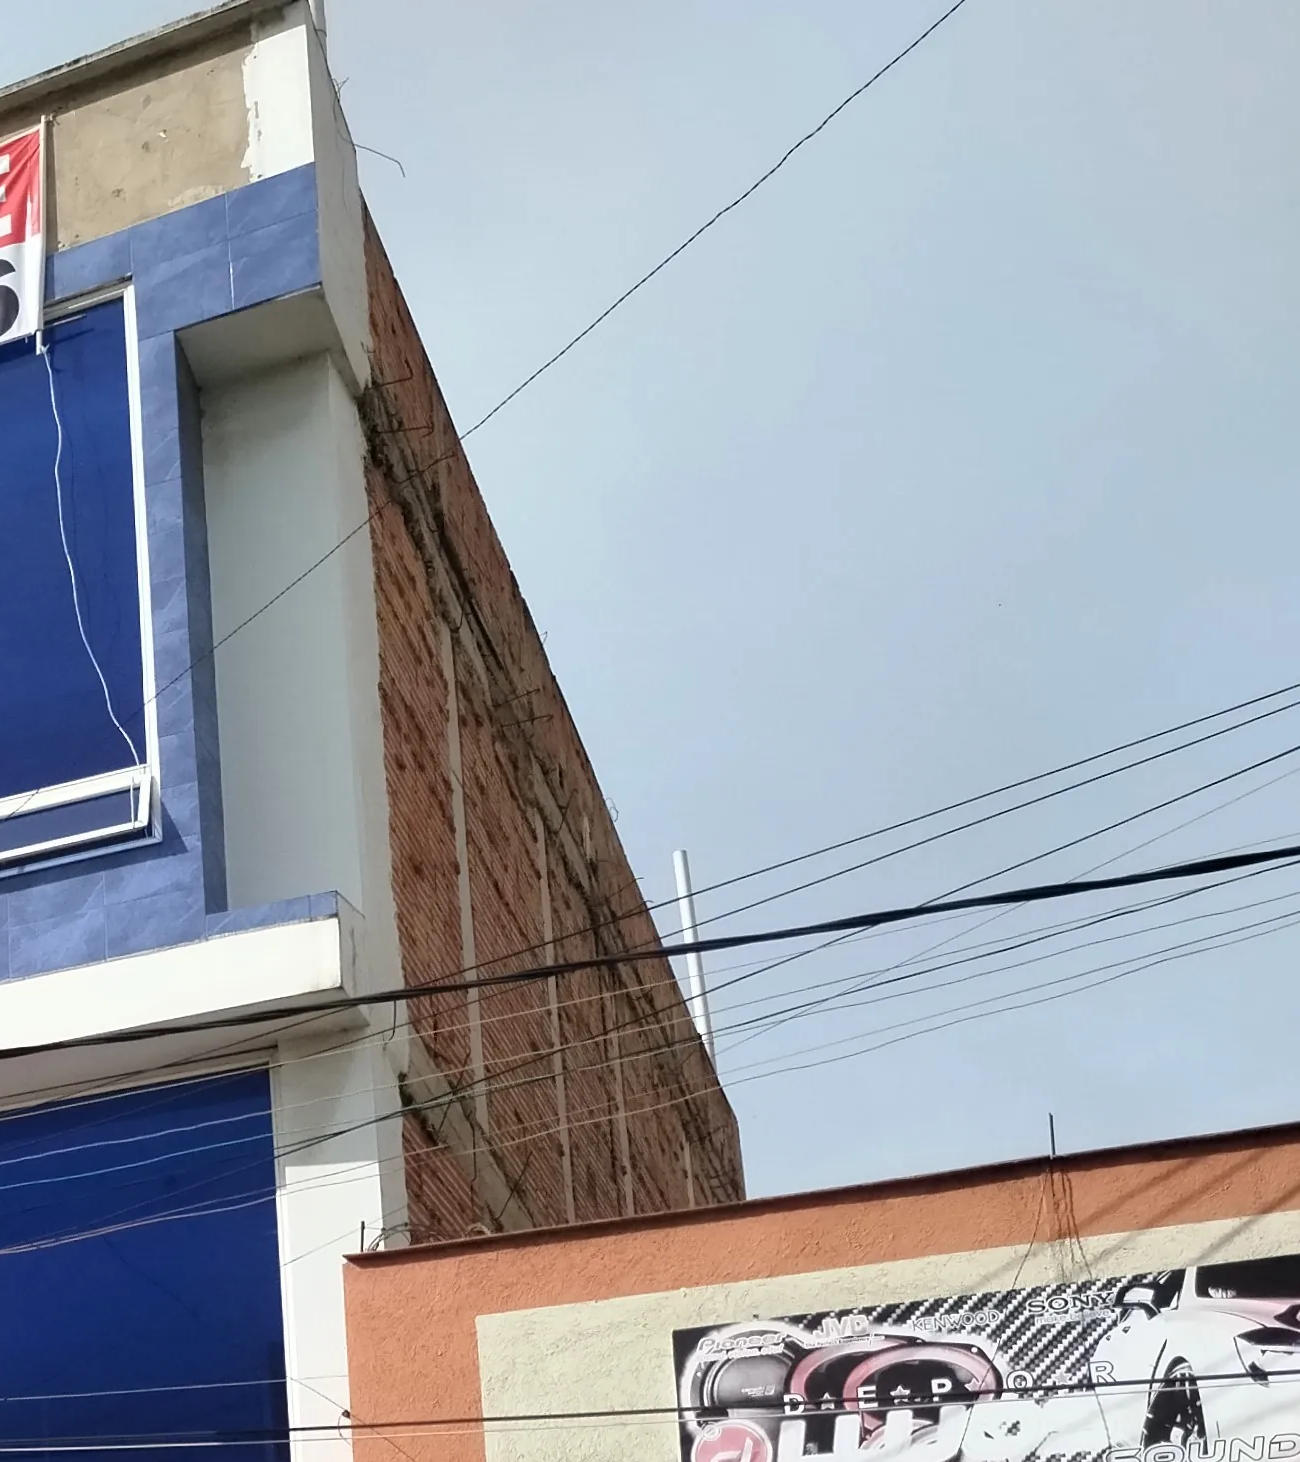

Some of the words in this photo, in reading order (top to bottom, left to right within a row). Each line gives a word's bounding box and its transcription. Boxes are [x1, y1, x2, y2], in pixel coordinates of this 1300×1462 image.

[1027, 1291, 1114, 1313] SONY
[912, 1309, 1001, 1332] KENWOOD
[699, 1332, 788, 1352] Pioneer
